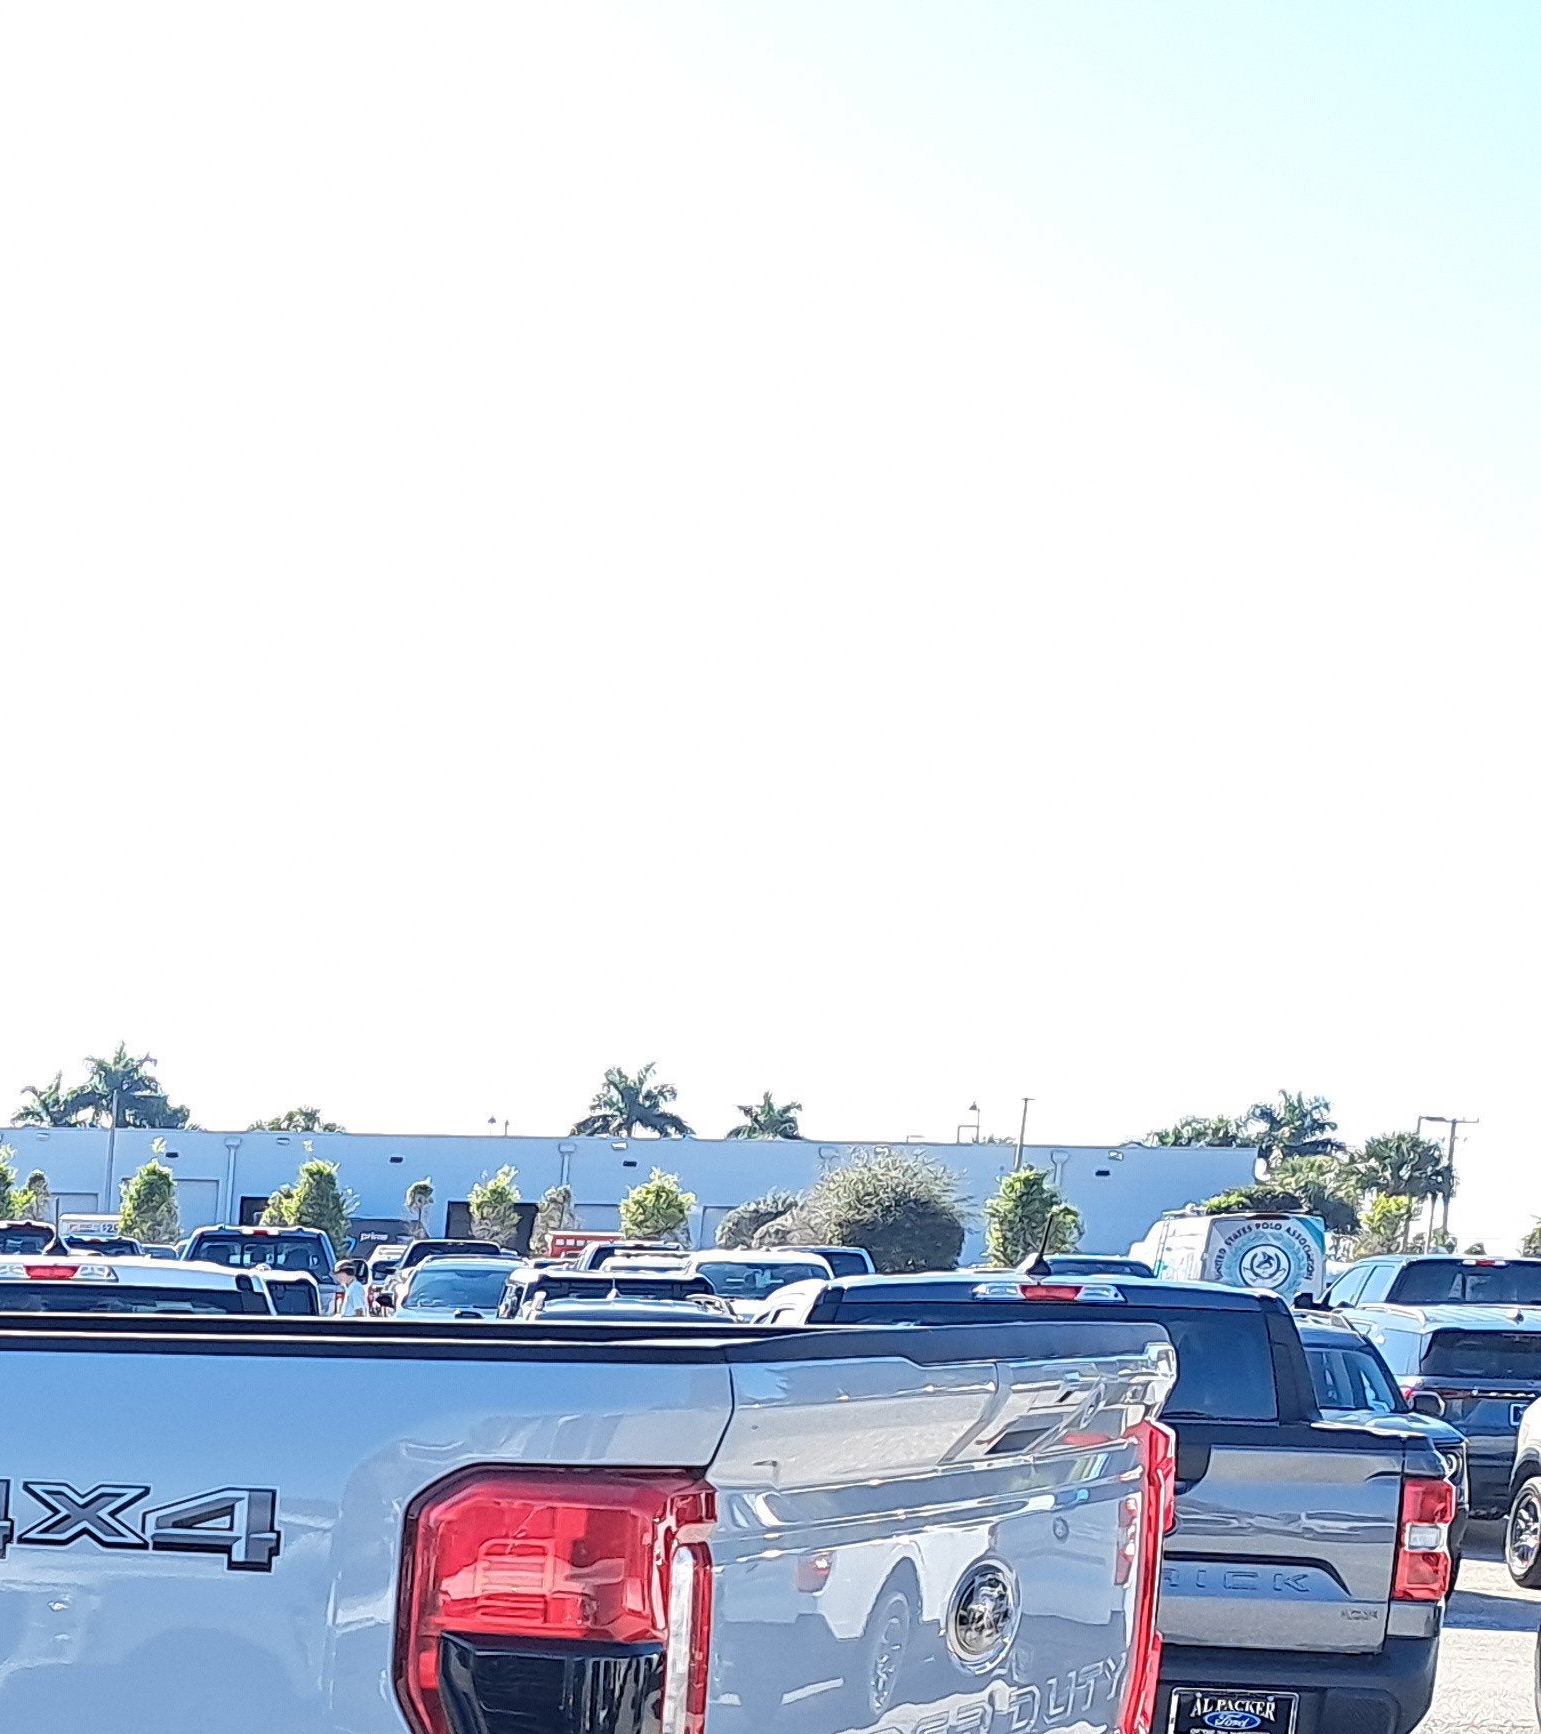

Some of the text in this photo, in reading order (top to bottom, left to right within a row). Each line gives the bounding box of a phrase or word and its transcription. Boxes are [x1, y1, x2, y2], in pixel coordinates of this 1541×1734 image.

[1224, 1223, 1254, 1246] STATES
[1254, 1221, 1283, 1231] POLO
[1190, 1697, 1276, 1722] AL PACKER
